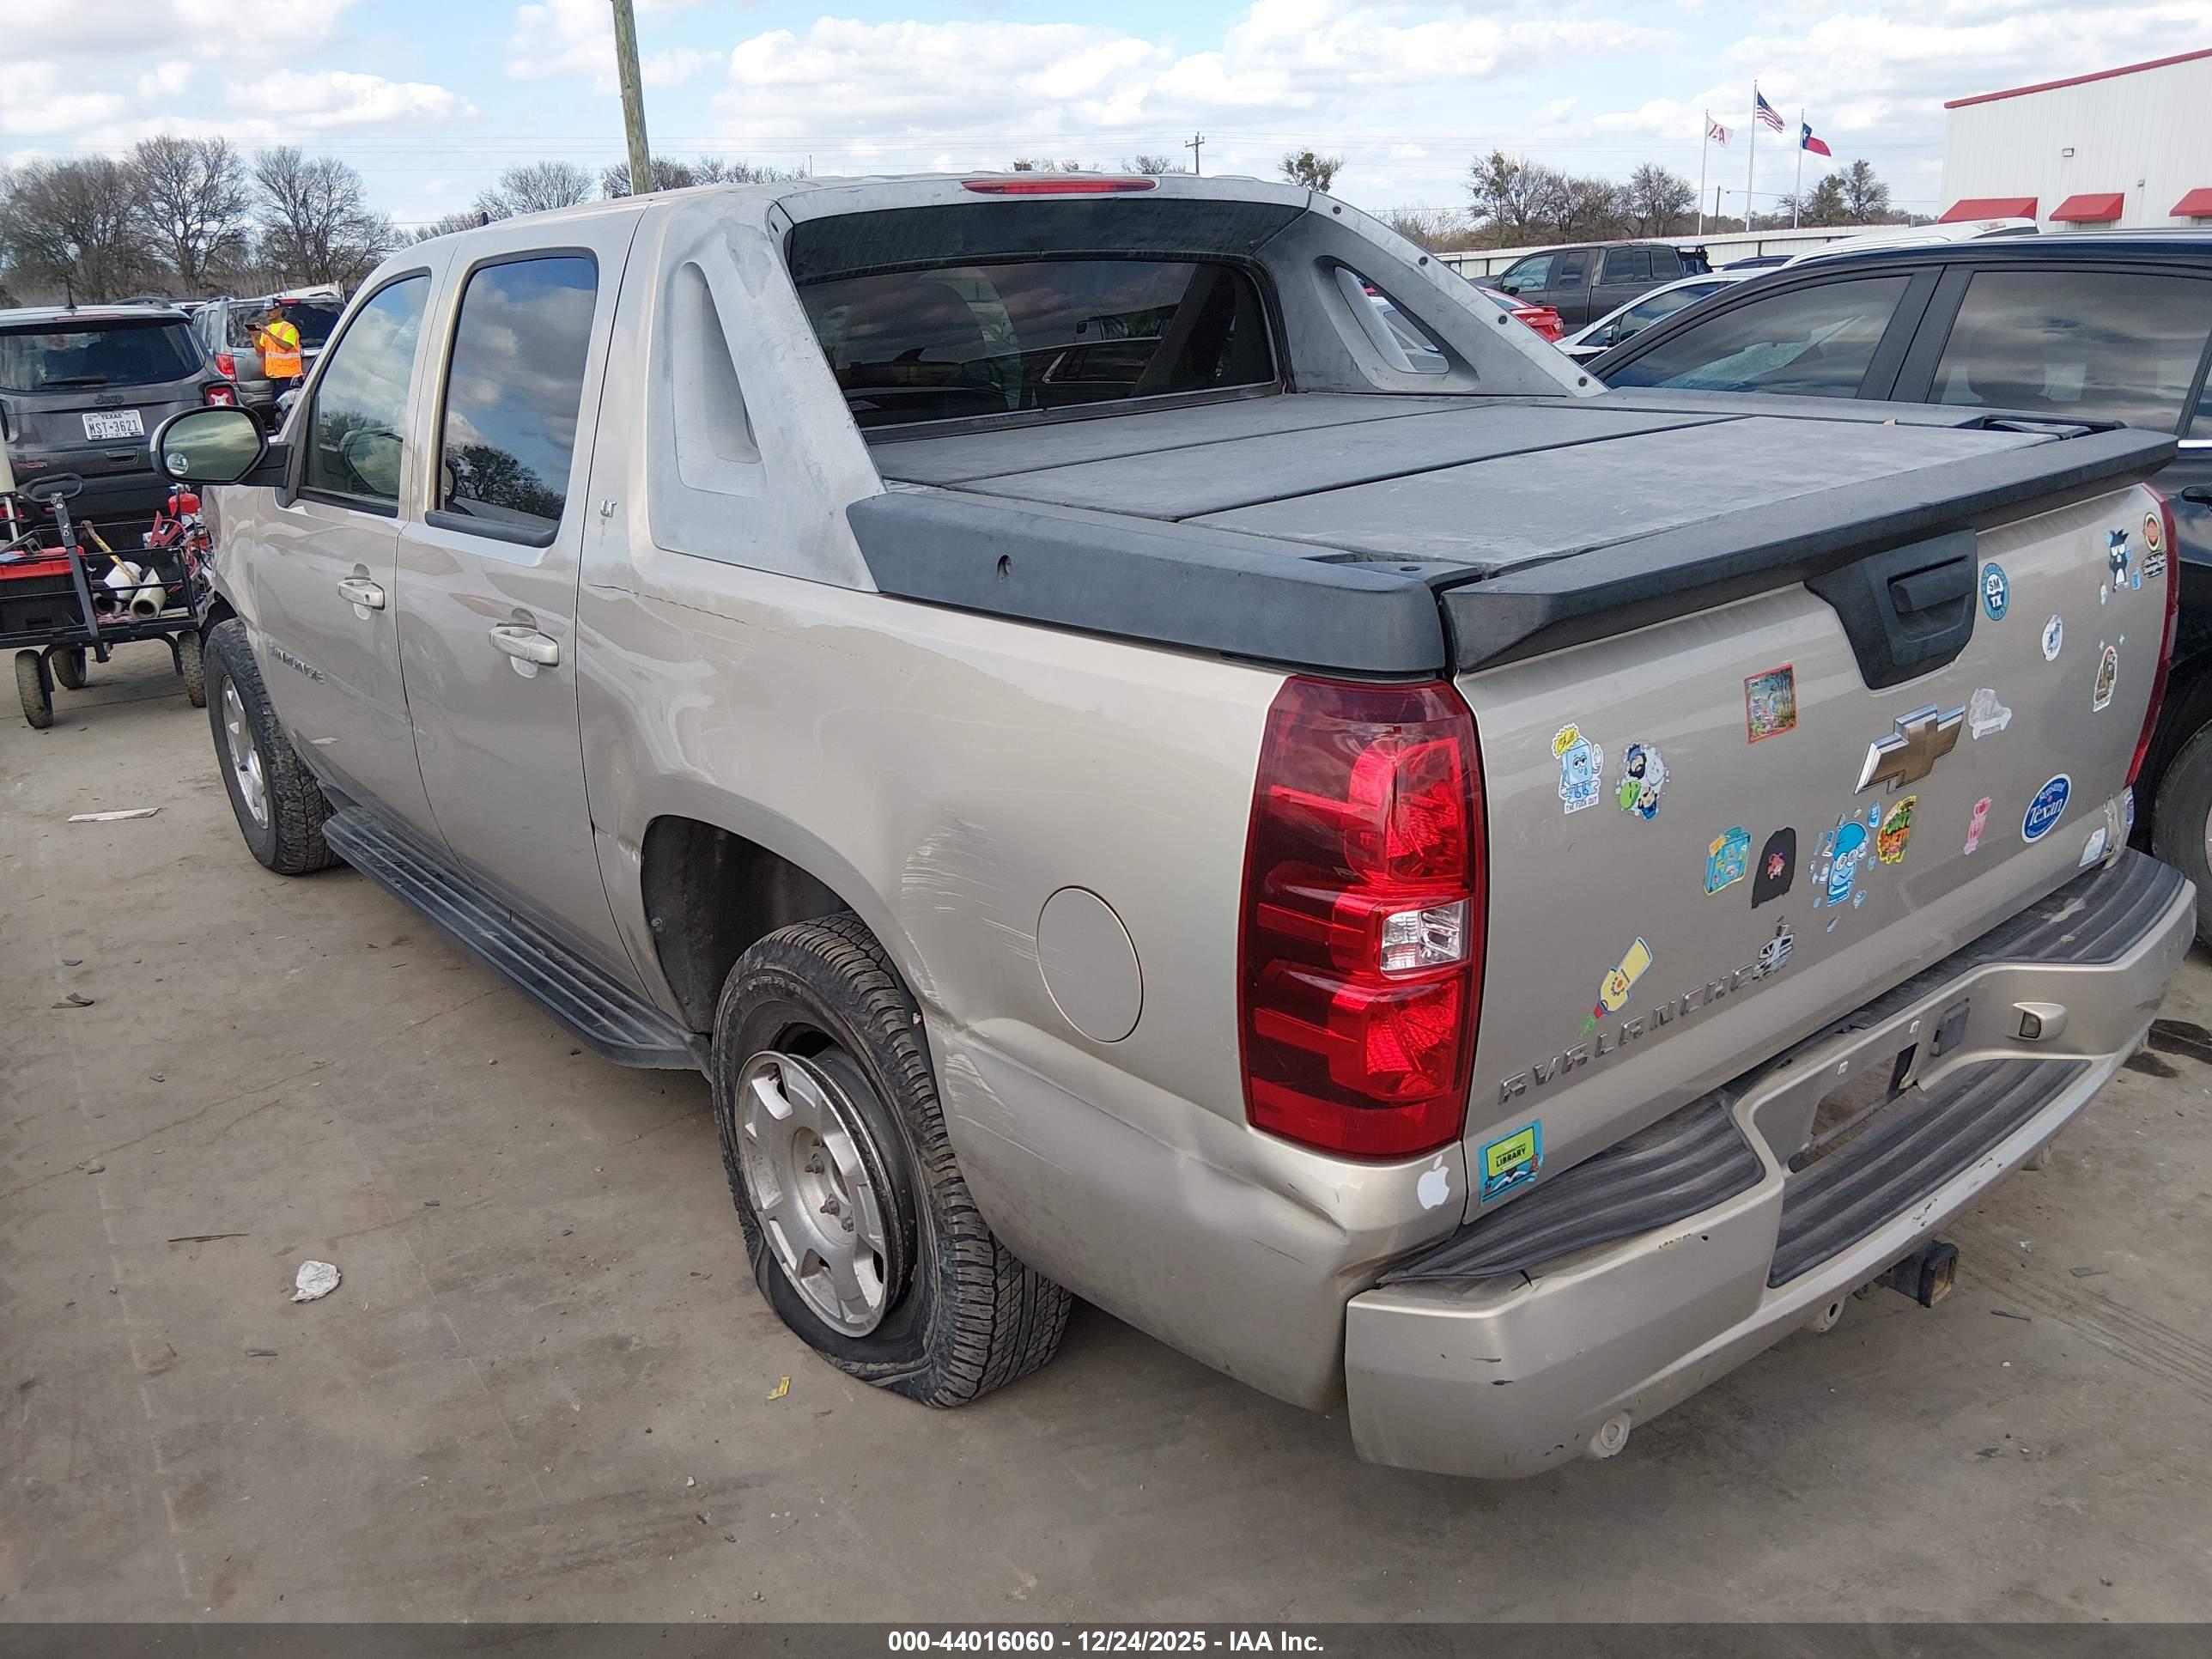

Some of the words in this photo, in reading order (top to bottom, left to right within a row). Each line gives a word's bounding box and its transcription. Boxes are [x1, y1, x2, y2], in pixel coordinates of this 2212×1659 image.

[95, 394, 124, 404] Jeep
[1989, 578, 2001, 592] SM
[1990, 594, 2003, 608] TX
[2027, 798, 2063, 827] Texan
[1498, 964, 1753, 1105] AVALANCHE
[1496, 1146, 1526, 1169] LIBRARY
